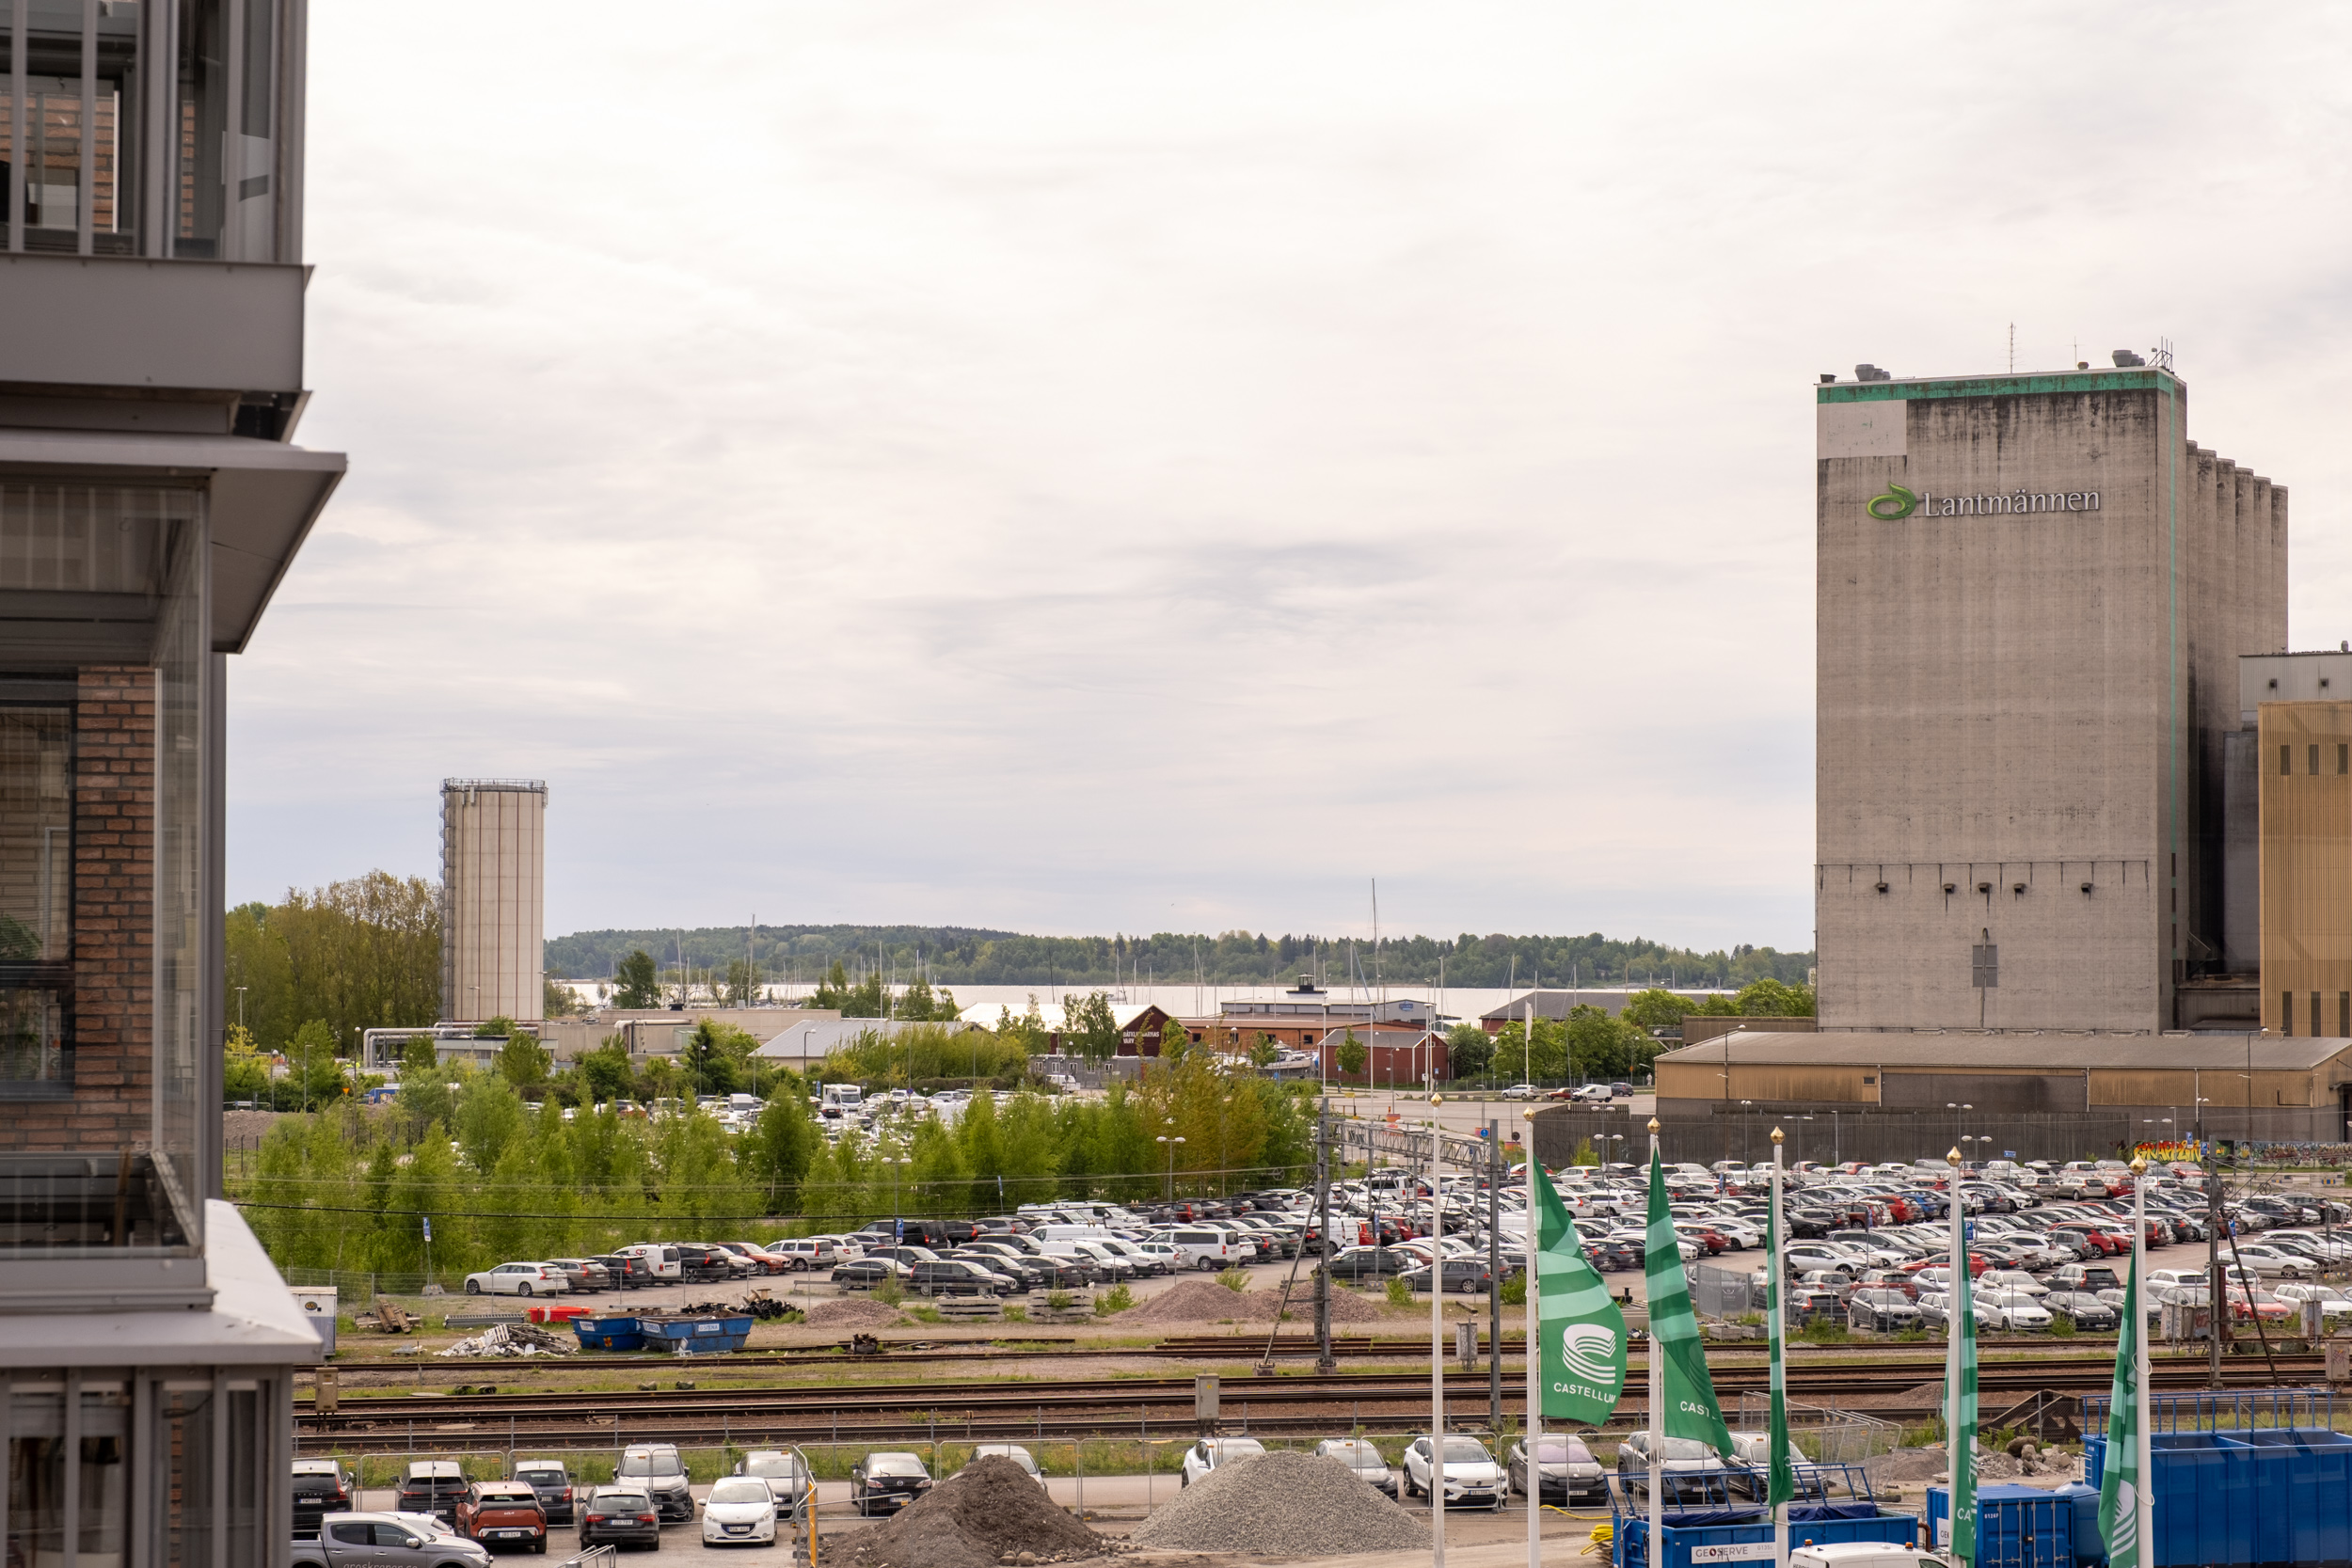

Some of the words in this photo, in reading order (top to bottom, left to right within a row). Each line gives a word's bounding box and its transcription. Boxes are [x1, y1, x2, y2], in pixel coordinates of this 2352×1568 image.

[1924, 488, 2100, 516] Lantmännen
[1553, 1382, 1616, 1404] CASTELLUM
[1680, 1401, 1716, 1420] CAST
[1957, 1507, 1972, 1522] CA
[1940, 1529, 1949, 1539] GE
[1695, 1545, 1749, 1558] GEOSERVE
